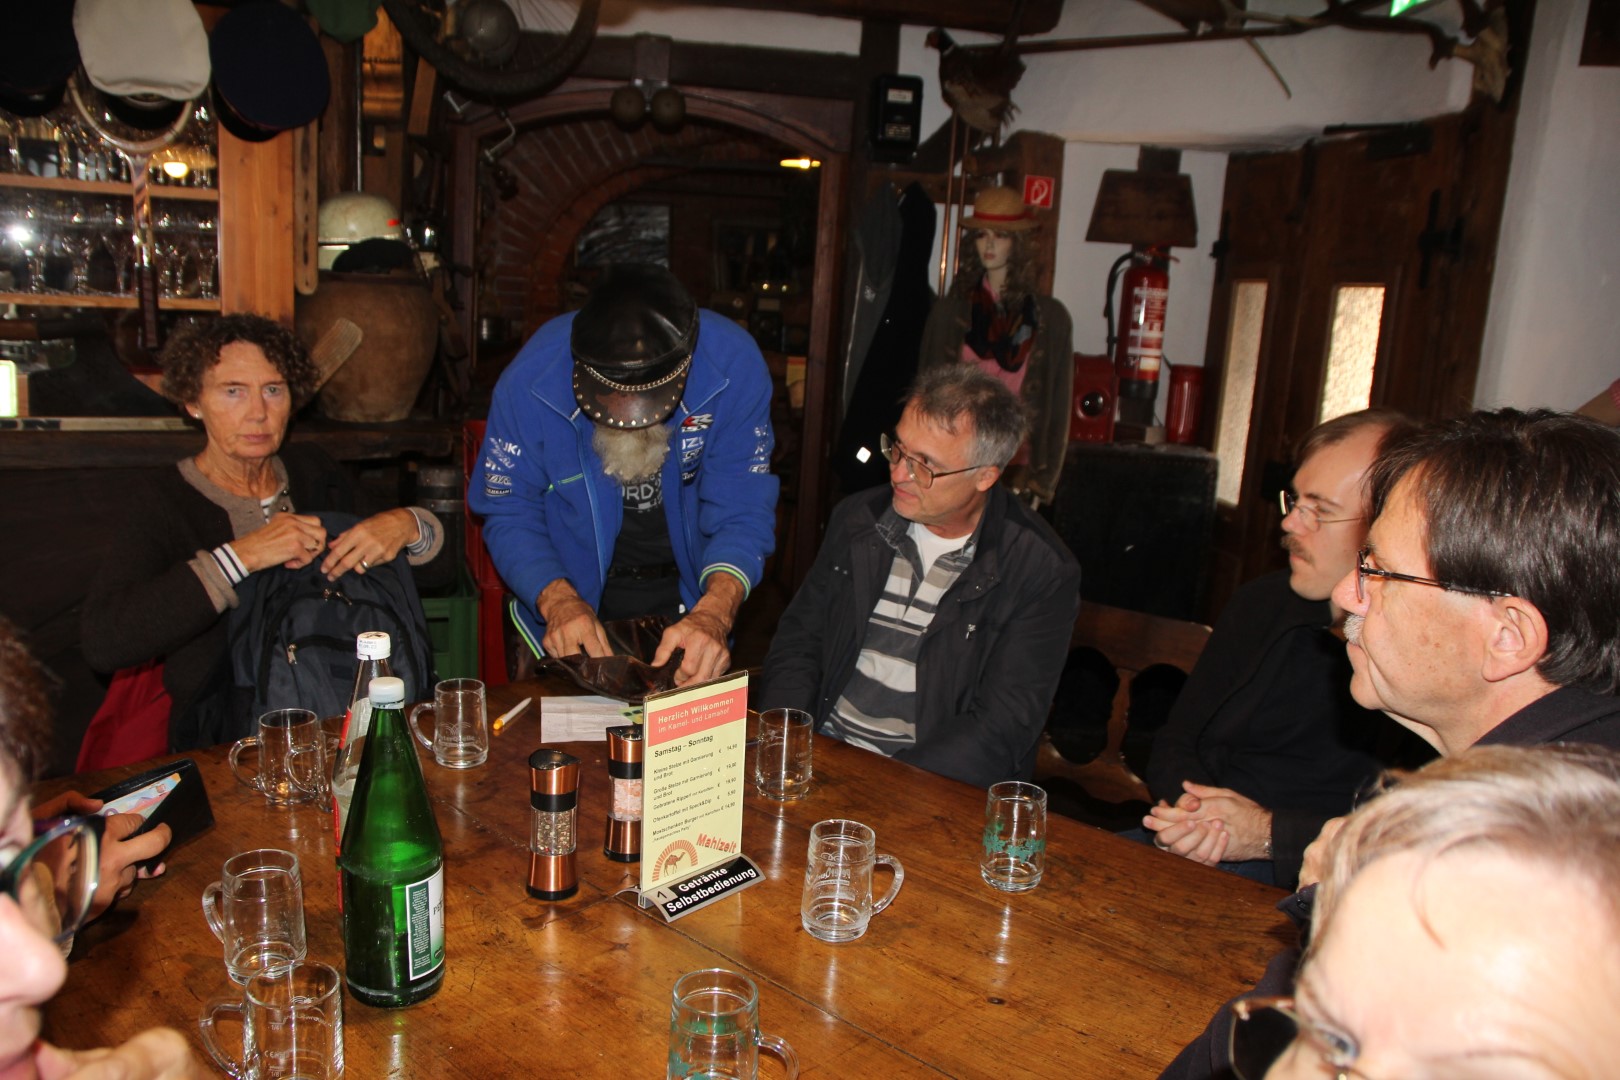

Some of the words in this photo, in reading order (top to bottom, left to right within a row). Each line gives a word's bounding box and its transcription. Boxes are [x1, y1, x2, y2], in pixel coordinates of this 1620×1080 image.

[622, 483, 655, 500] RD
[658, 709, 689, 724] Herzlich
[690, 698, 734, 715] Willkommen
[668, 720, 690, 730] Kamel-
[691, 716, 703, 724] und
[704, 706, 730, 720] Lamahof
[654, 744, 682, 758] Samstag
[688, 735, 714, 748] Sonntag
[653, 783, 667, 794] Große
[663, 790, 673, 798] Brot
[696, 833, 737, 853] Mahlzeit
[666, 868, 757, 912] Selbstbedienung
[678, 867, 728, 892] Getränke
